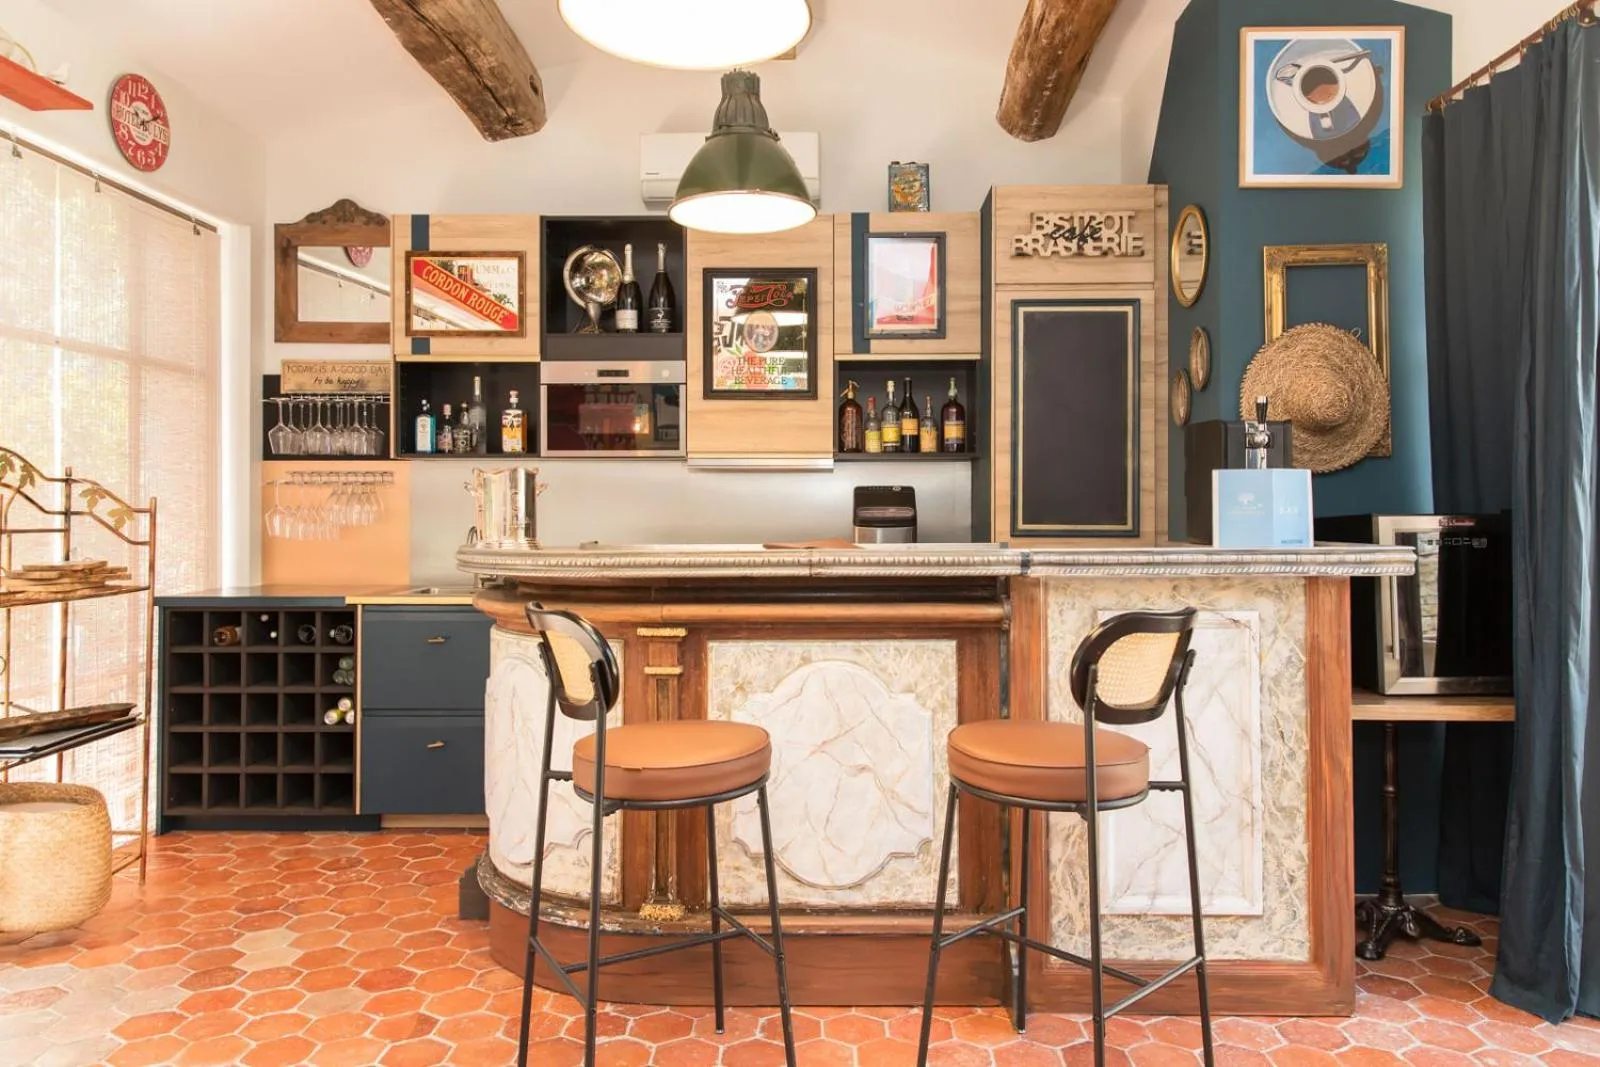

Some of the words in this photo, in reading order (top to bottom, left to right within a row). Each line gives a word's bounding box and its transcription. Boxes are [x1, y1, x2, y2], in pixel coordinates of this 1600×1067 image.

[422, 265, 467, 301] CORDON
[467, 293, 508, 325] ROUGE
[738, 357, 757, 366] THE
[759, 357, 785, 366] PURE
[734, 376, 788, 385] BEVERAGE
